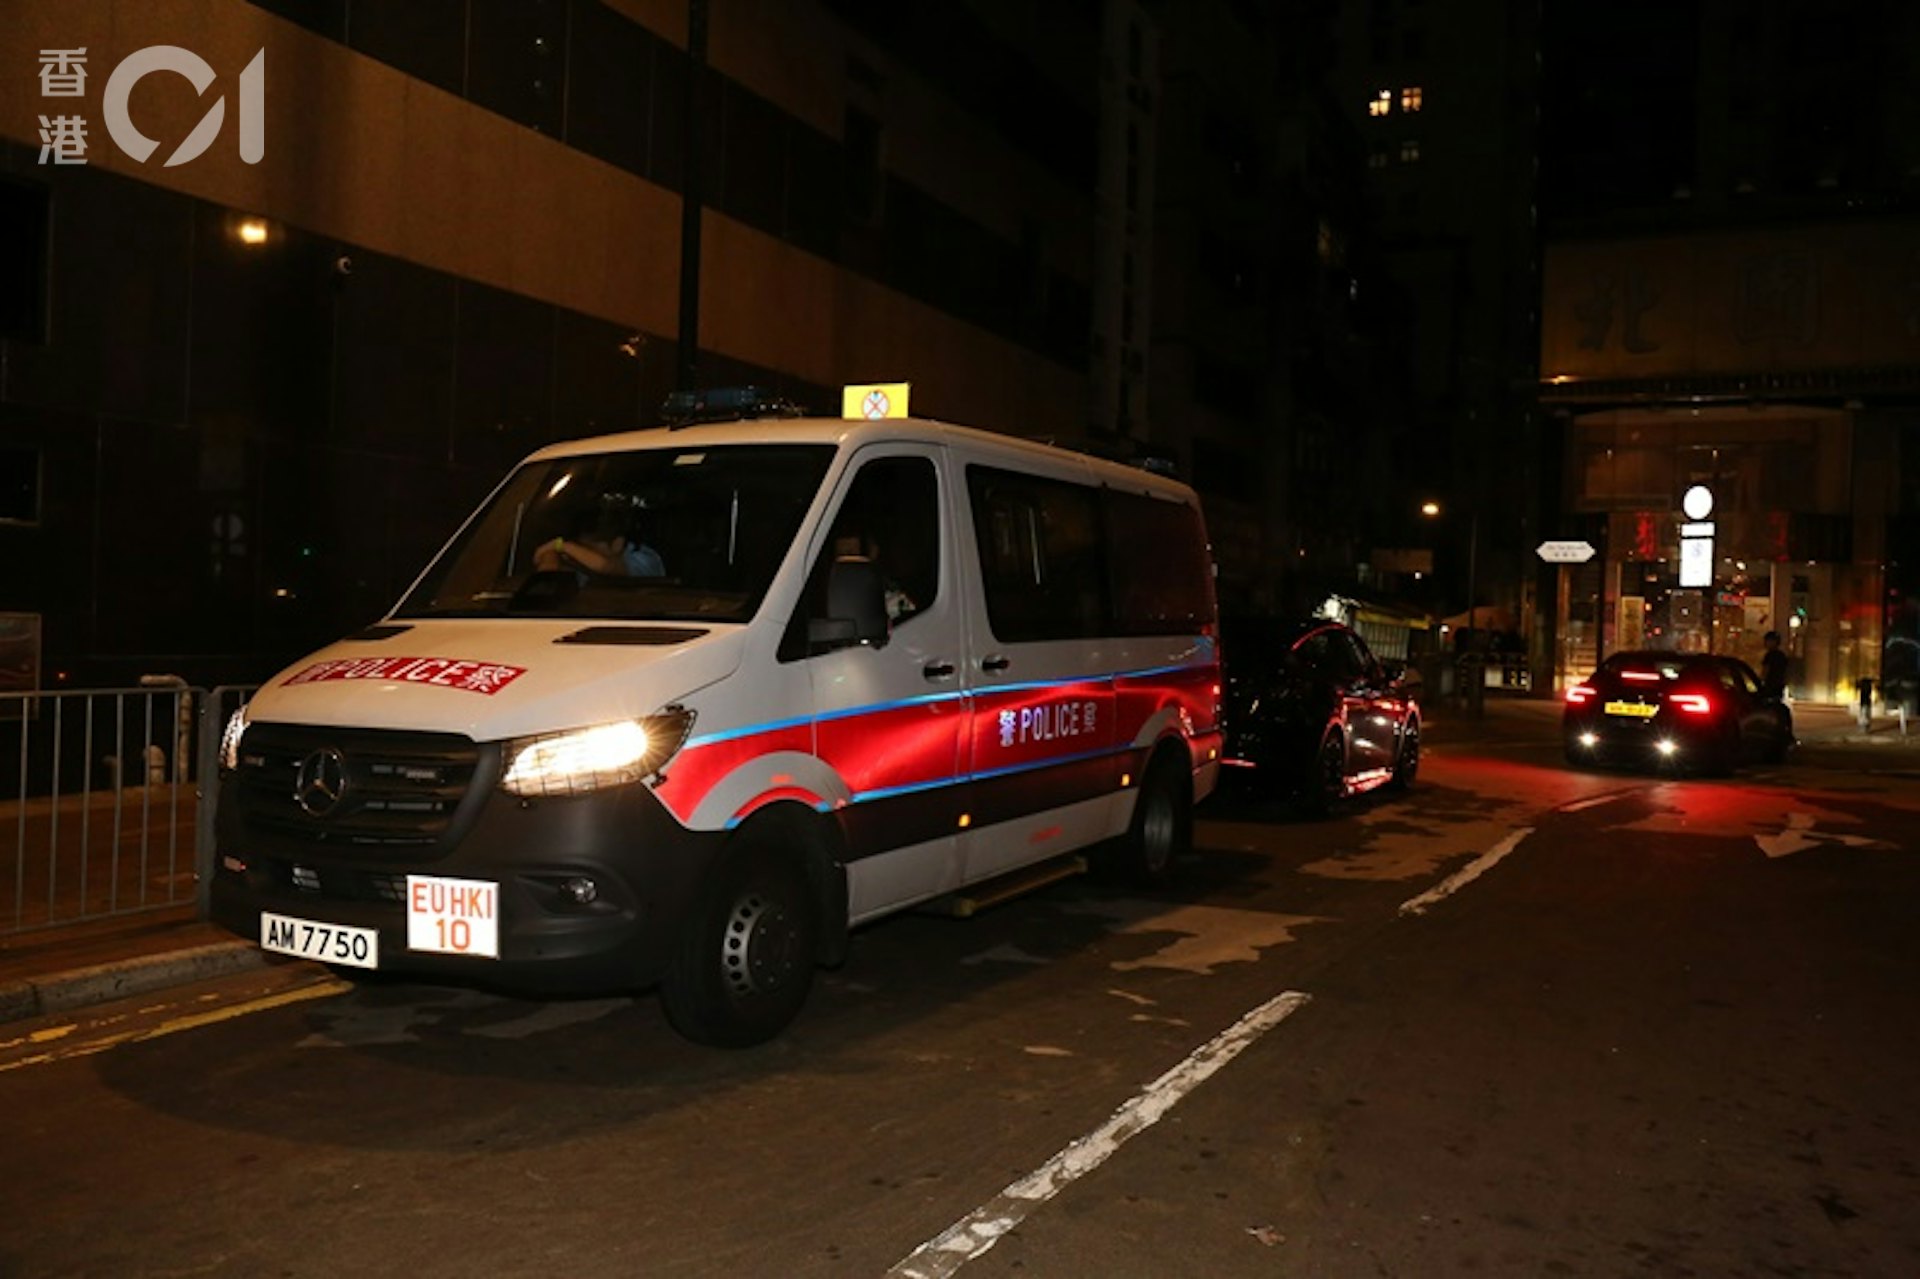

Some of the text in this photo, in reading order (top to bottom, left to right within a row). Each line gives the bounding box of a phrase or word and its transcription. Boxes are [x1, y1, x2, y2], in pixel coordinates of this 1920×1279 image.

[317, 658, 479, 685] POLICE
[1019, 702, 1080, 744] POLICE
[267, 920, 369, 961] AM 7750
[436, 919, 471, 951] 10
